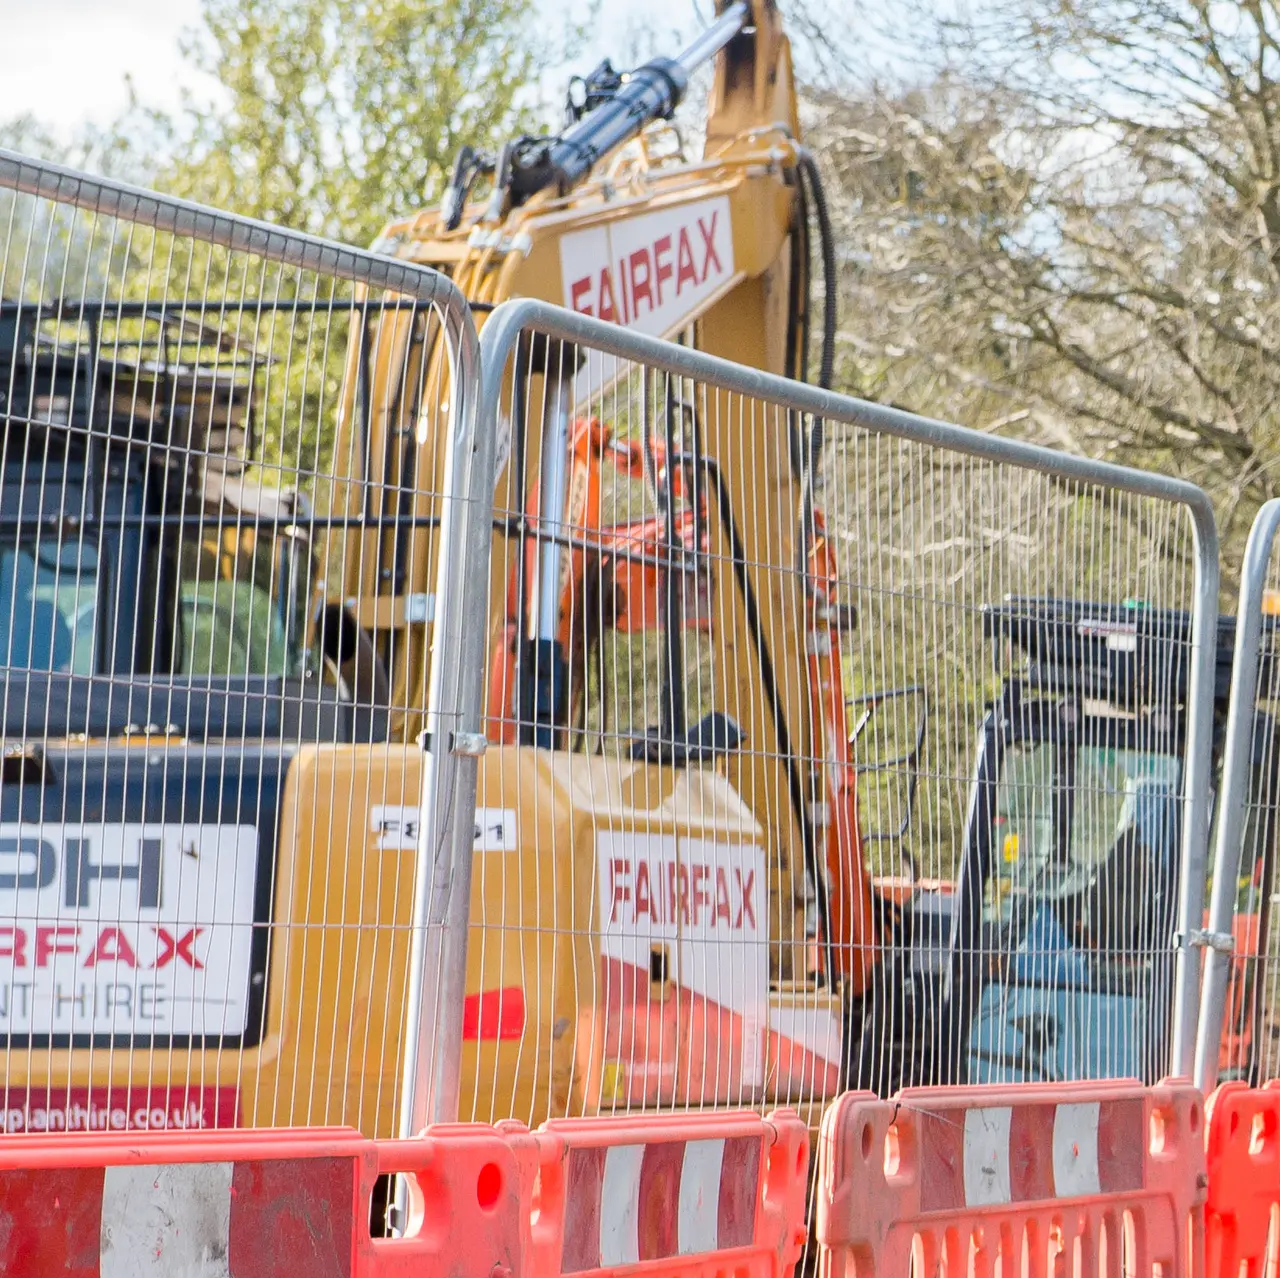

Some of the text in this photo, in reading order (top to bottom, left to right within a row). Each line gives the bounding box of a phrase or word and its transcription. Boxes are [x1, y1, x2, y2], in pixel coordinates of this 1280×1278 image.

[571, 209, 722, 326] FAIRFAX
[609, 857, 757, 930] FAIRFAX
[55, 983, 166, 1020] HIRE
[0, 1101, 207, 1133] planthire.co.uk
